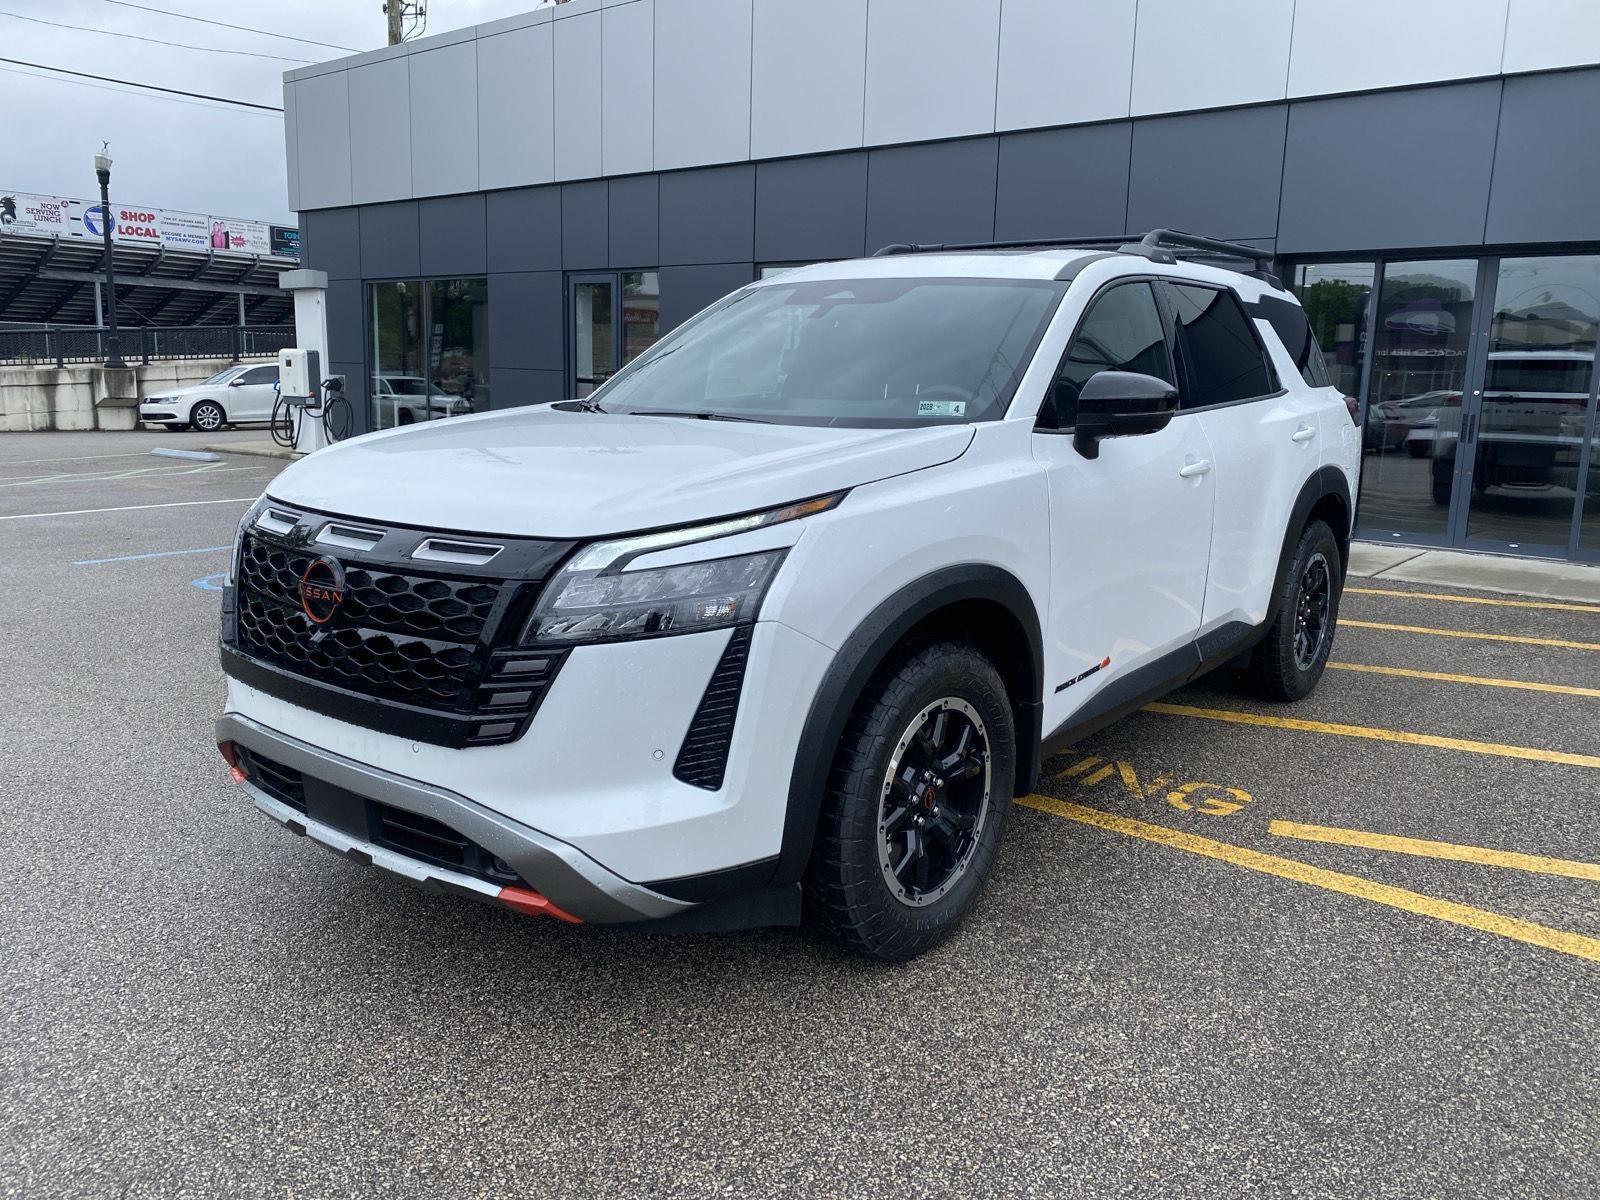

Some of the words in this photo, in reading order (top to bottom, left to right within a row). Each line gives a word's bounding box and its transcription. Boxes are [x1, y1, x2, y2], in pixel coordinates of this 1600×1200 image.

[40, 202, 60, 210] NOW
[25, 207, 60, 217] SERVING
[120, 210, 155, 223] SHOP
[33, 214, 61, 223] LUNCH
[117, 225, 160, 238] LOCAL
[953, 404, 960, 413] 4
[301, 587, 343, 603] SSAN
